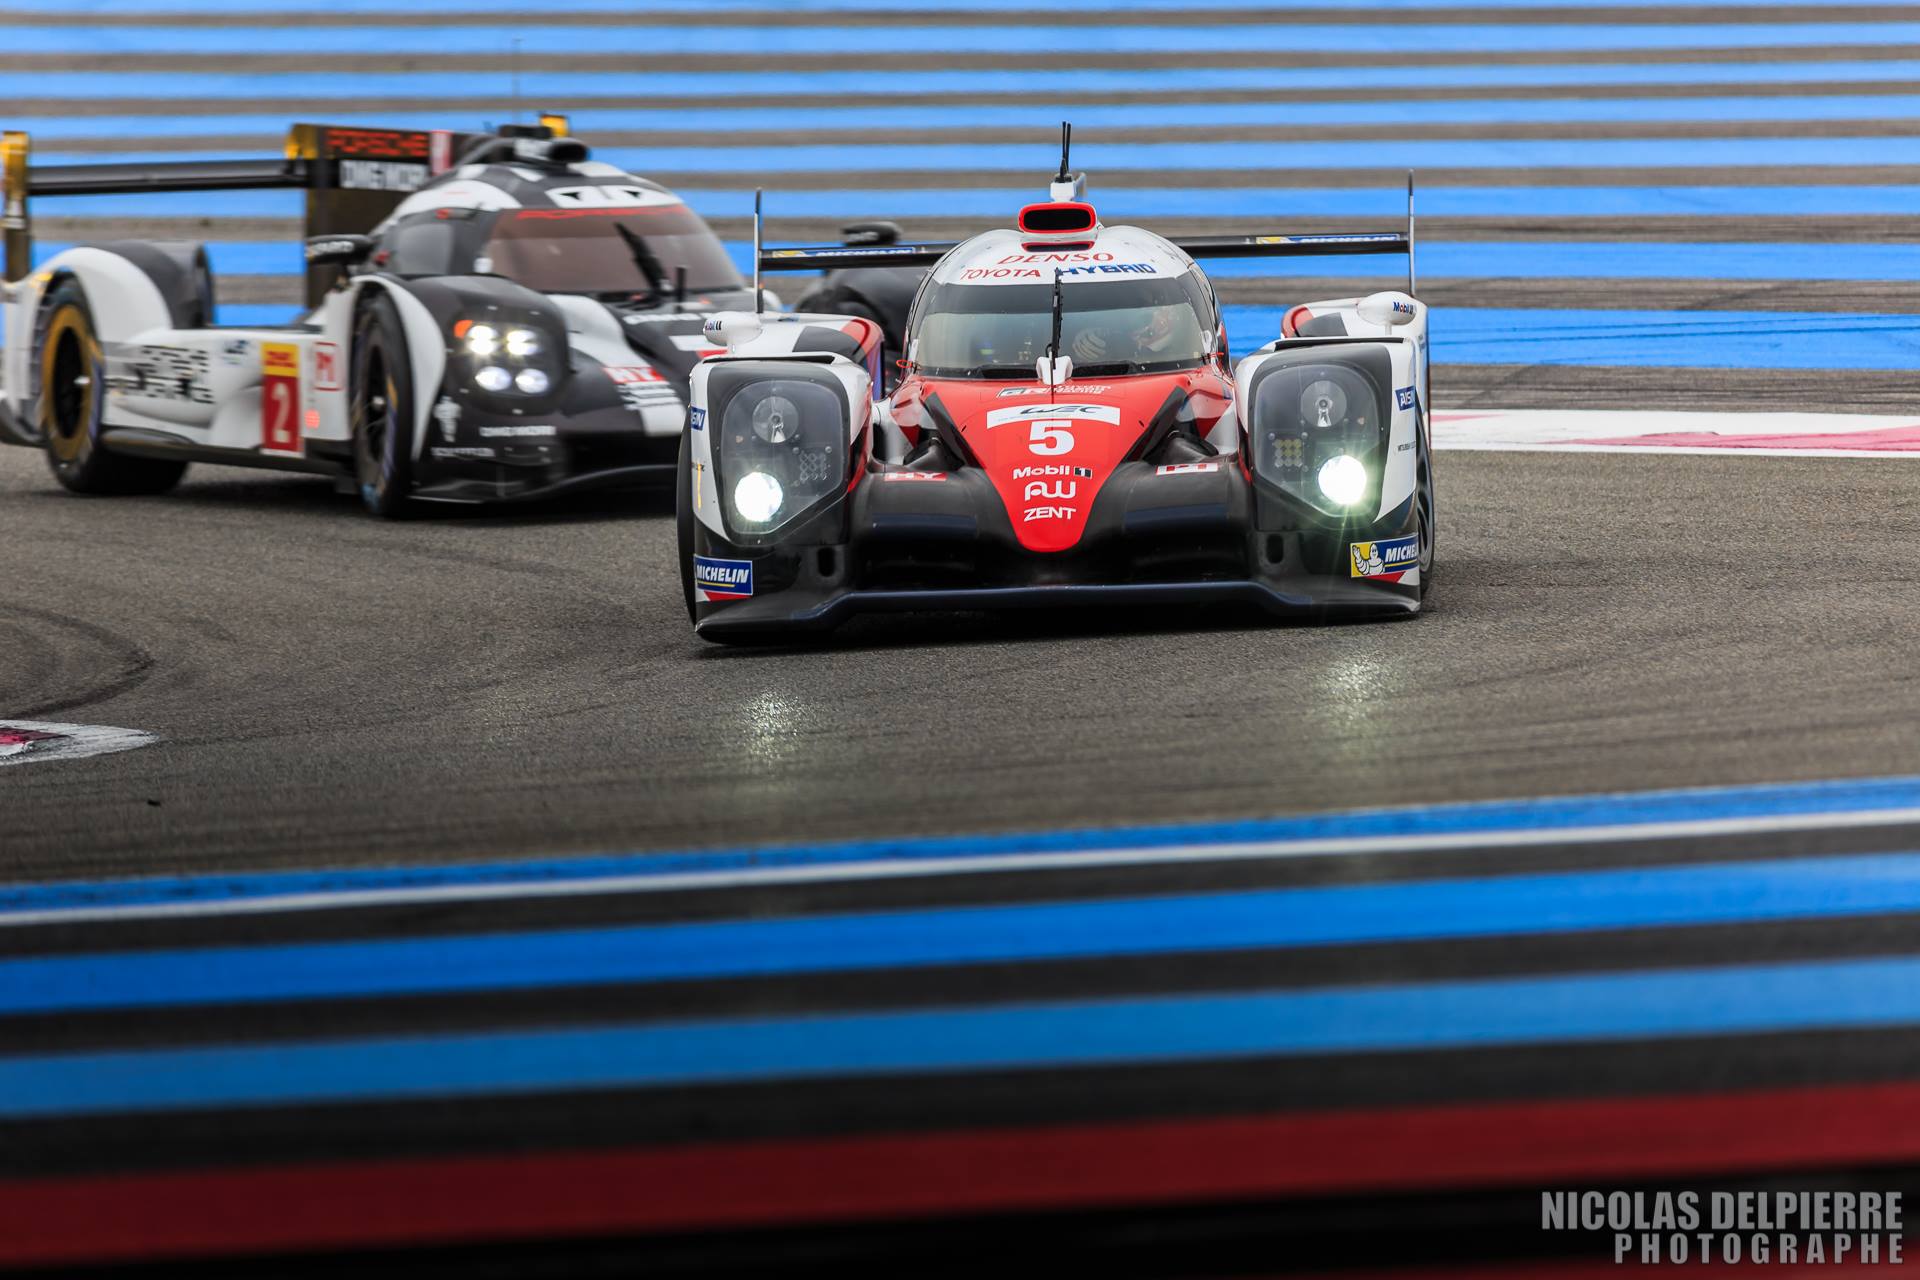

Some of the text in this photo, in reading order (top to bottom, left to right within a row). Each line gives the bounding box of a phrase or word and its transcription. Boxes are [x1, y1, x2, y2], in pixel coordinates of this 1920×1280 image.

[997, 253, 1114, 264] DENSO
[960, 263, 1157, 281] TOYOTA HYBRID
[271, 382, 291, 444] 2
[1028, 420, 1075, 456] 5
[1013, 465, 1070, 480] Mobil
[1024, 507, 1077, 522] ZENT
[696, 564, 750, 584] MICHELIN
